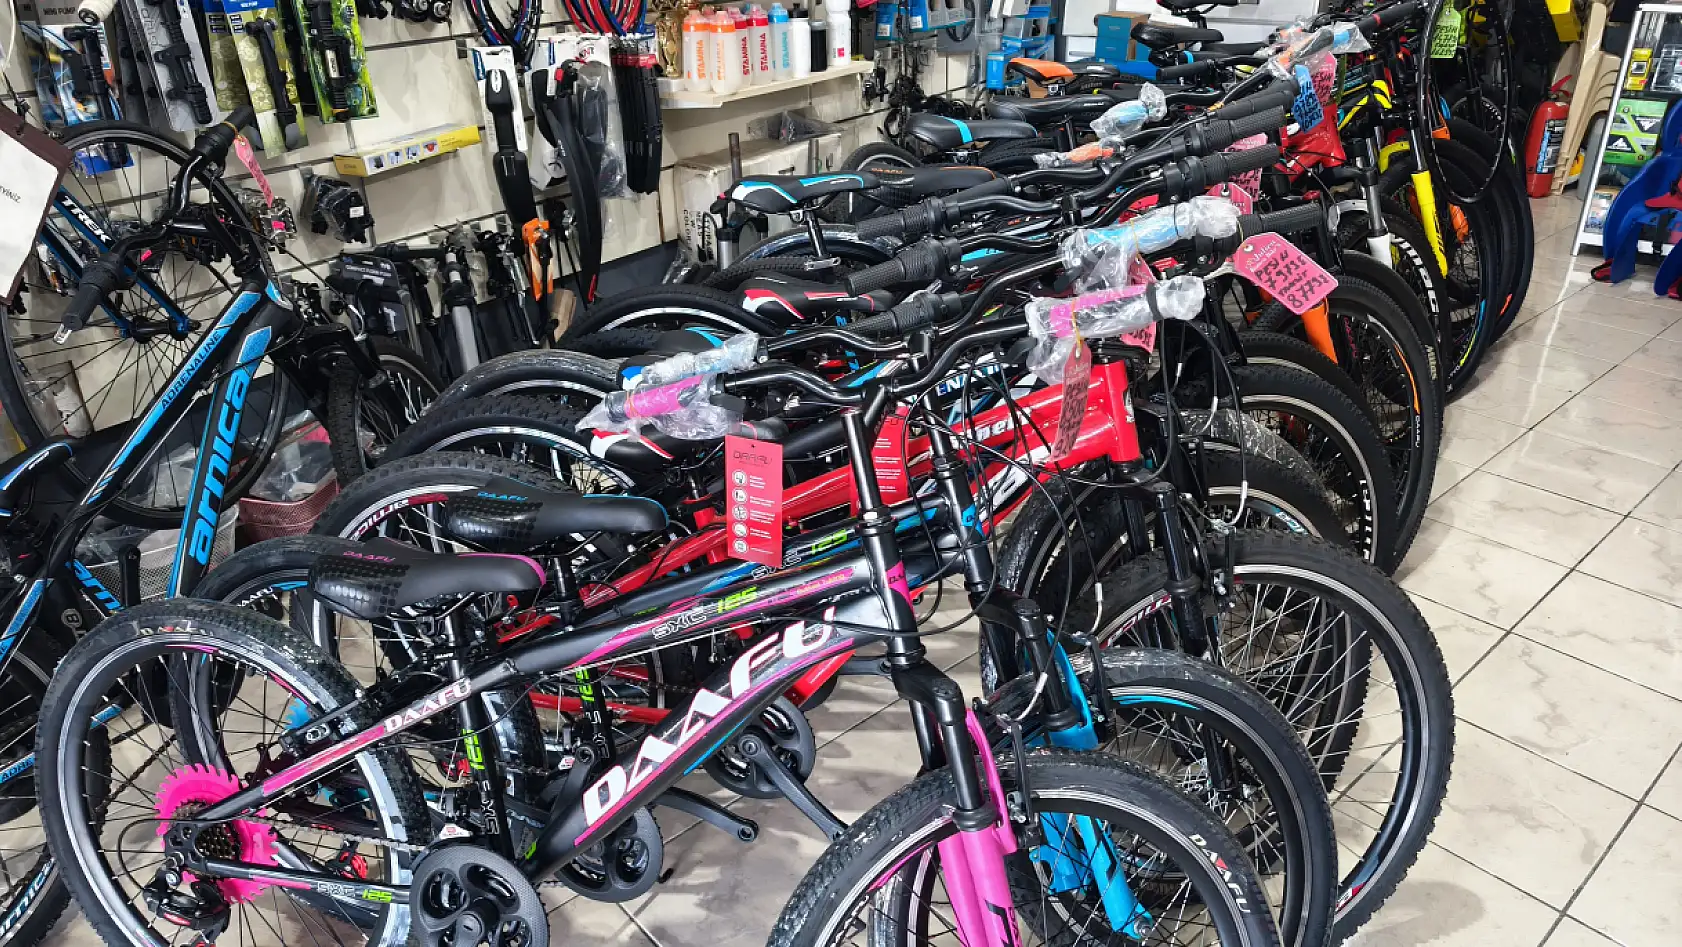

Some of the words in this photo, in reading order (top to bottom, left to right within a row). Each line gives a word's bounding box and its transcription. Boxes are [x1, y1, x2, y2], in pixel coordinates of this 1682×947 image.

[696, 39, 706, 79] STAMINA
[760, 32, 769, 72] STAMINA
[782, 31, 790, 69] STAMINA
[61, 195, 112, 243] TREK
[161, 332, 221, 411] ADRENALINE
[189, 368, 250, 566] arnica
[343, 551, 396, 563] DAAFU
[811, 527, 848, 555] 125
[652, 604, 708, 640] SXC
[717, 586, 759, 614] 125
[384, 677, 473, 733] DAAFU
[582, 605, 836, 828] DAAFU
[462, 728, 486, 770] 125
[362, 888, 393, 903] 125
[1189, 833, 1251, 913] DAAFU
